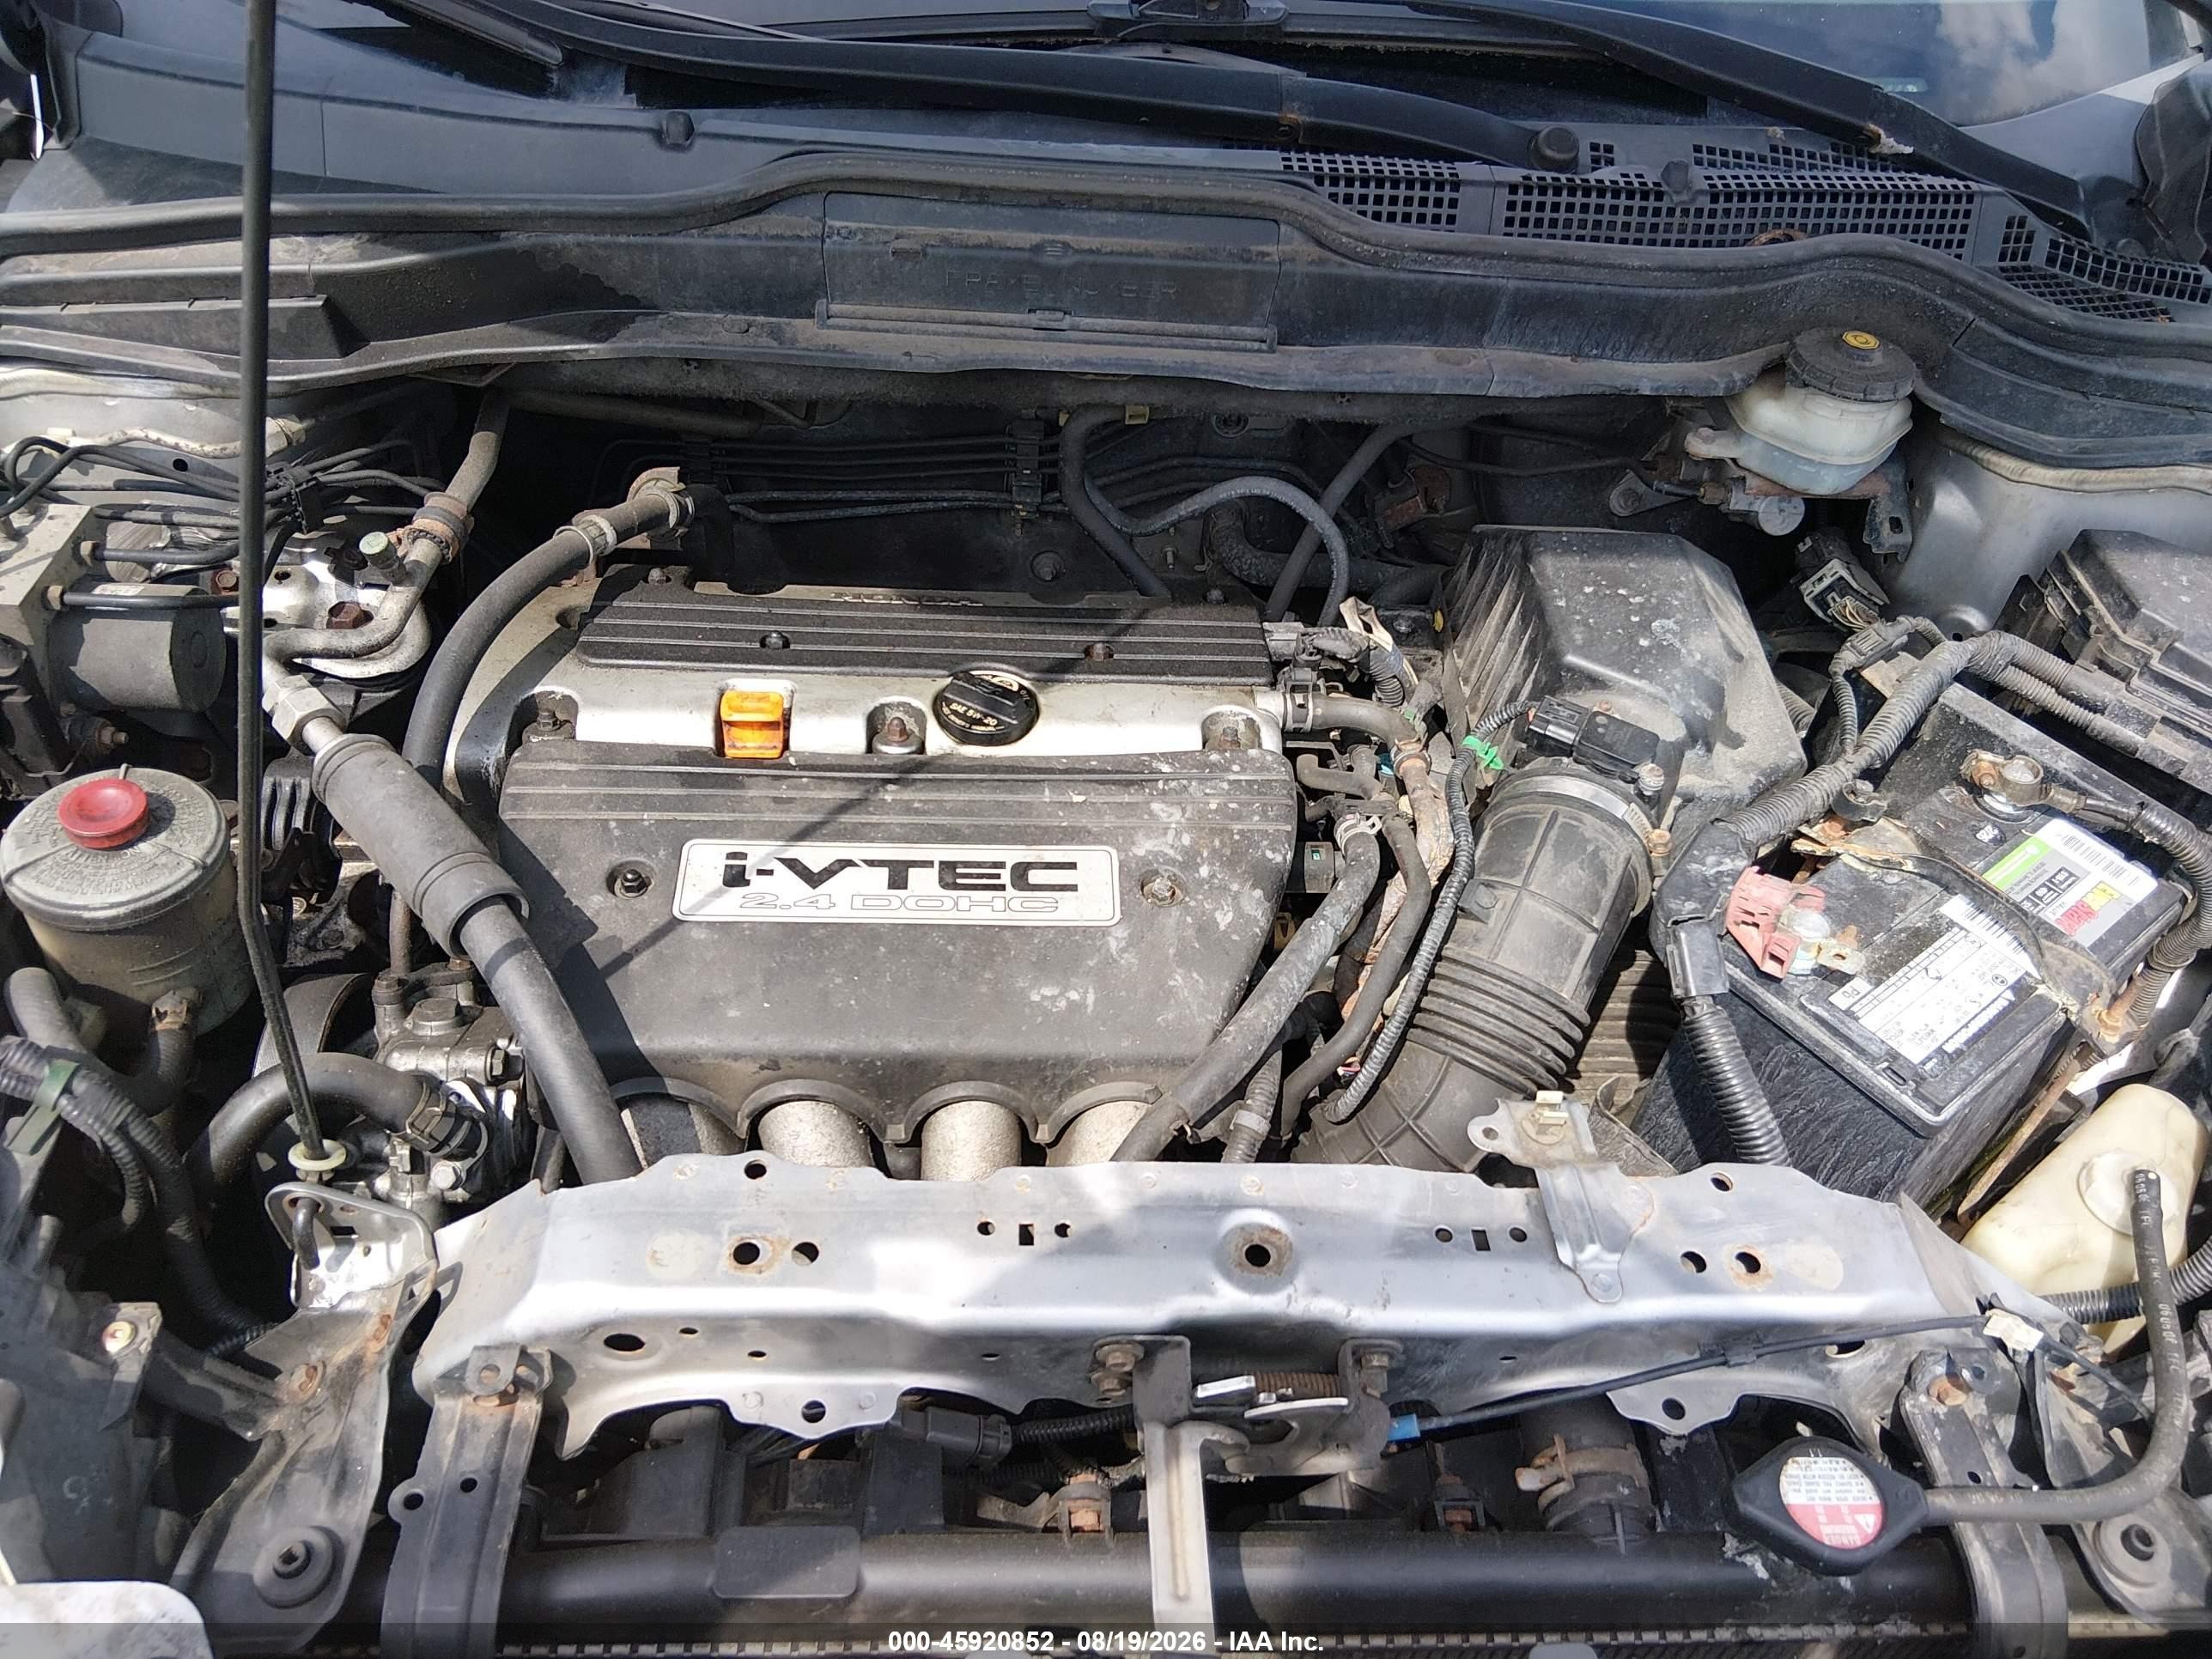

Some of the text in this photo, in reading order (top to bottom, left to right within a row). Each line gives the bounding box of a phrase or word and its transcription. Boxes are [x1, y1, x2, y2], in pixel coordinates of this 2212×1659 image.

[950, 702, 998, 726] SAE 5W-20
[722, 851, 1079, 892] i-VTEC
[740, 892, 1059, 913] 2.4 DOHC
[1842, 986, 1861, 999] Pb
